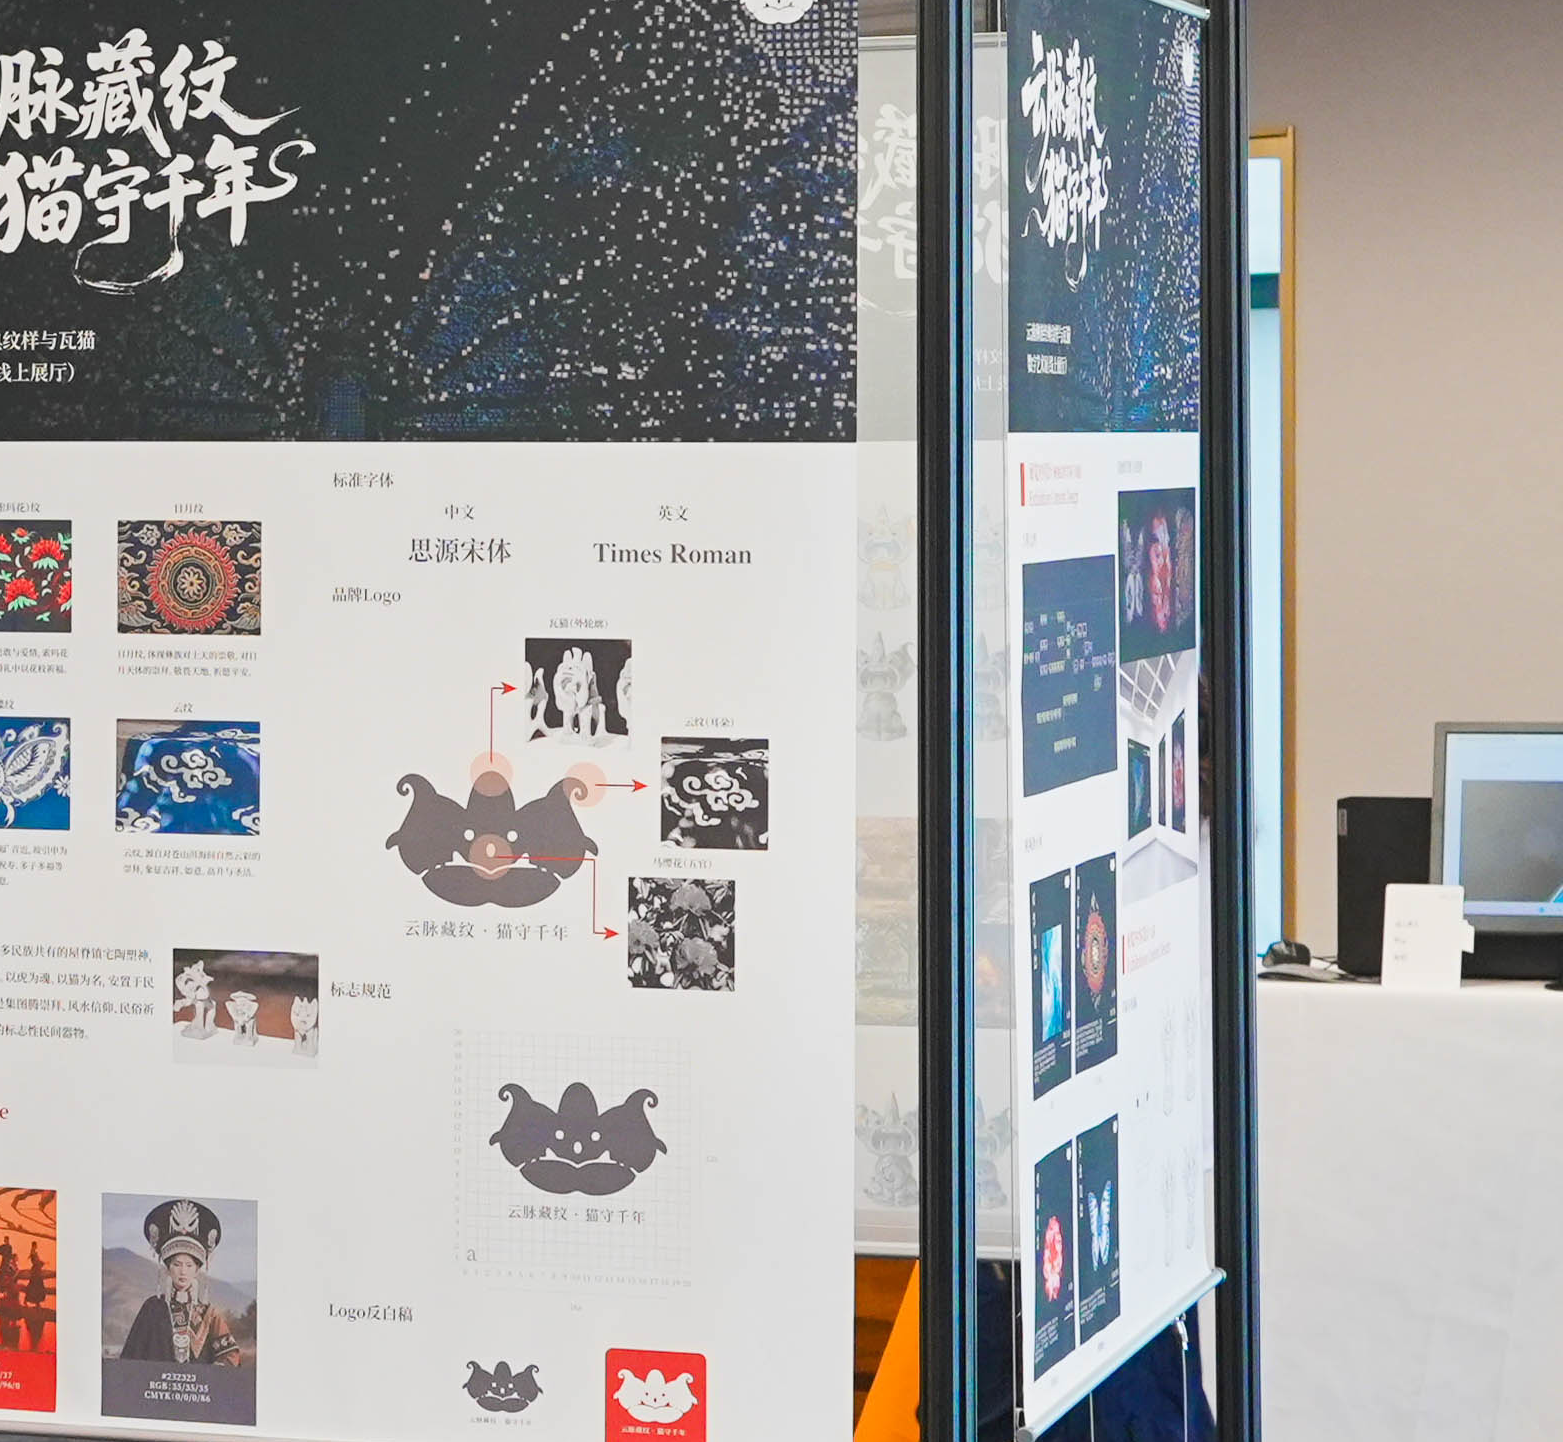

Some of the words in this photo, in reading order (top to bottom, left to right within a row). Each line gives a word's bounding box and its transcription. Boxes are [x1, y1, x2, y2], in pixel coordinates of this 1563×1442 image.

[332, 472, 394, 489] 标准字体
[444, 504, 475, 521] 中文
[658, 504, 688, 521] 英文
[408, 537, 512, 564] 思源宋体
[593, 542, 663, 564] Times
[669, 543, 752, 565] Roman
[332, 586, 402, 606] 品牌Logo
[330, 981, 392, 1000] 标志规范
[329, 1303, 413, 1323] Logo反白稿
